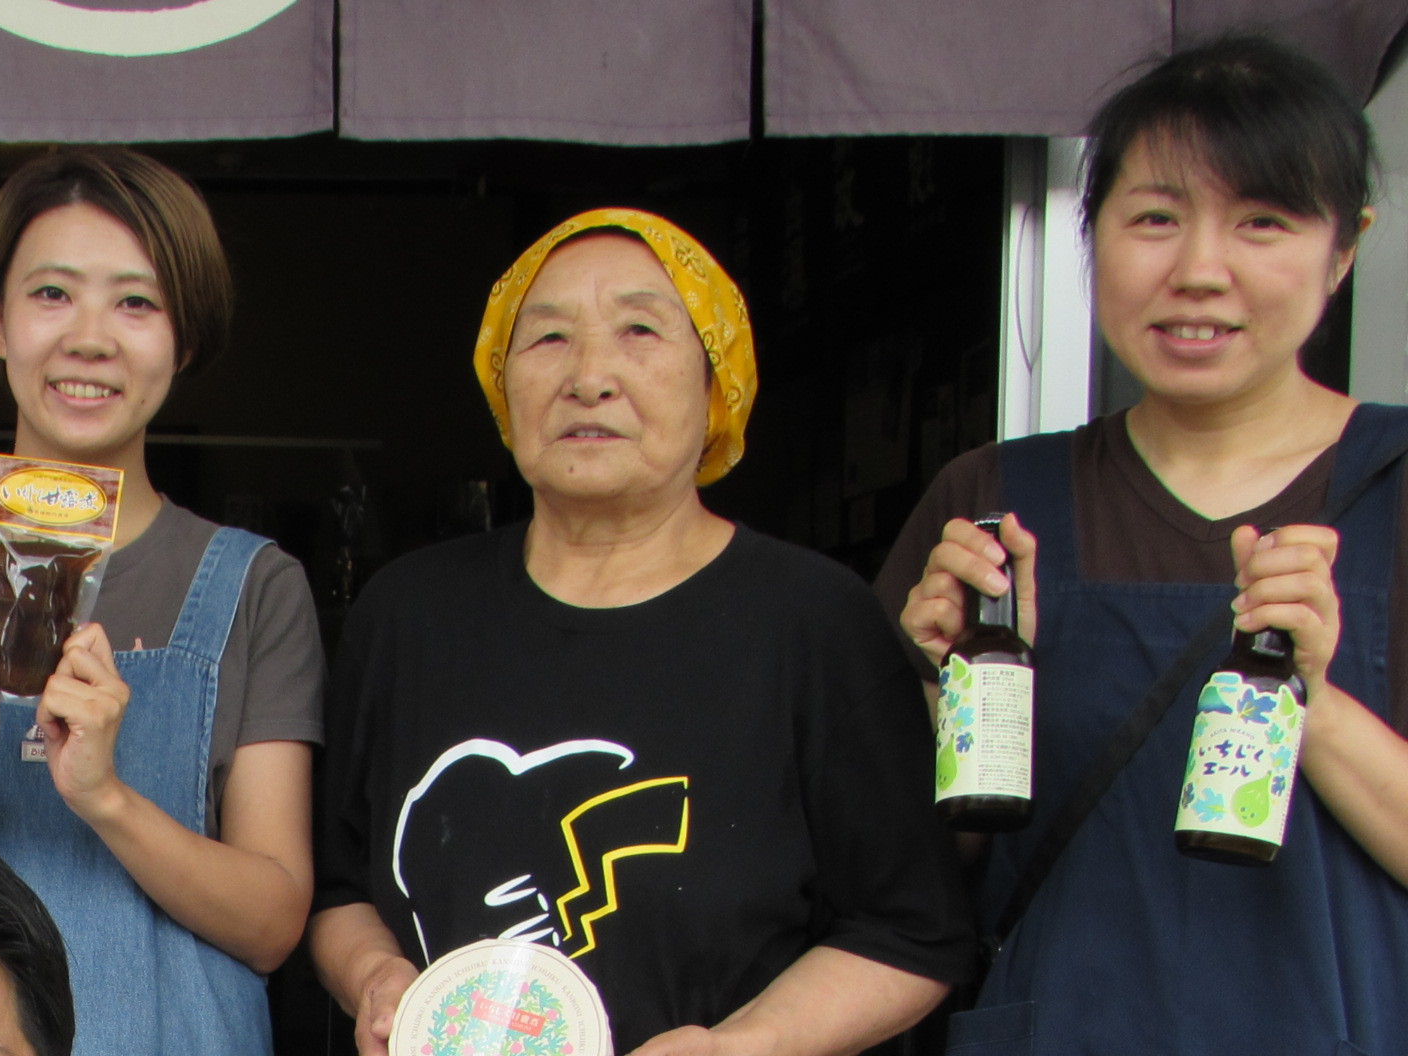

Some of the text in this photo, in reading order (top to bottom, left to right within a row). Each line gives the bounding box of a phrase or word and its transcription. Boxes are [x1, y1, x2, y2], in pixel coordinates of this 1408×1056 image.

[1199, 740, 1264, 762] いちじく
[1203, 762, 1250, 777] エール
